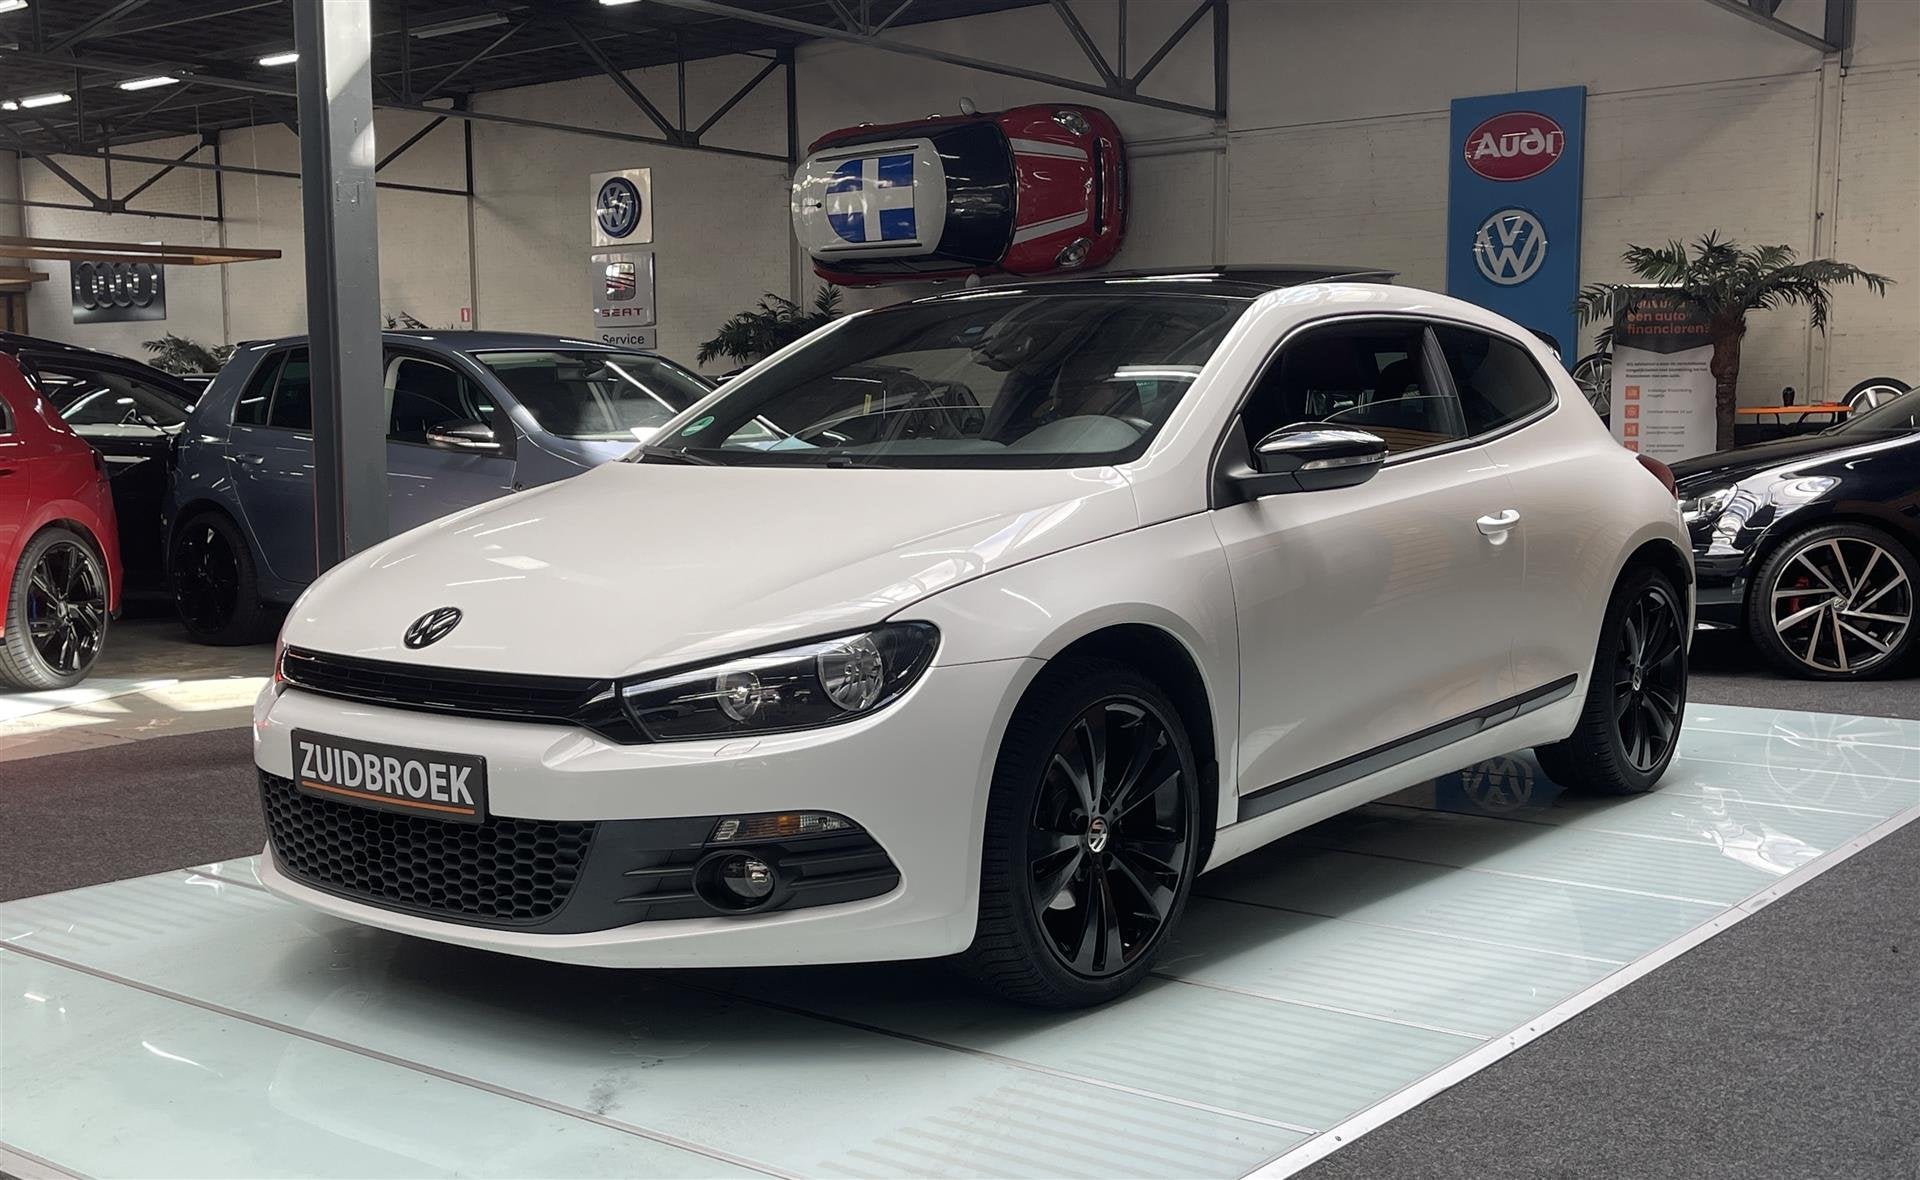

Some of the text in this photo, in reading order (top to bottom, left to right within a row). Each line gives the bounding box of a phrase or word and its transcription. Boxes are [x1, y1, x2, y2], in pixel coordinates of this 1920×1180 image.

[1474, 128, 1555, 159] Audi
[1478, 210, 1546, 285] VW
[601, 307, 643, 318] SEAT
[1655, 312, 1686, 321] auto
[602, 333, 645, 345] Service
[299, 741, 475, 806] ZUIDBROEK
